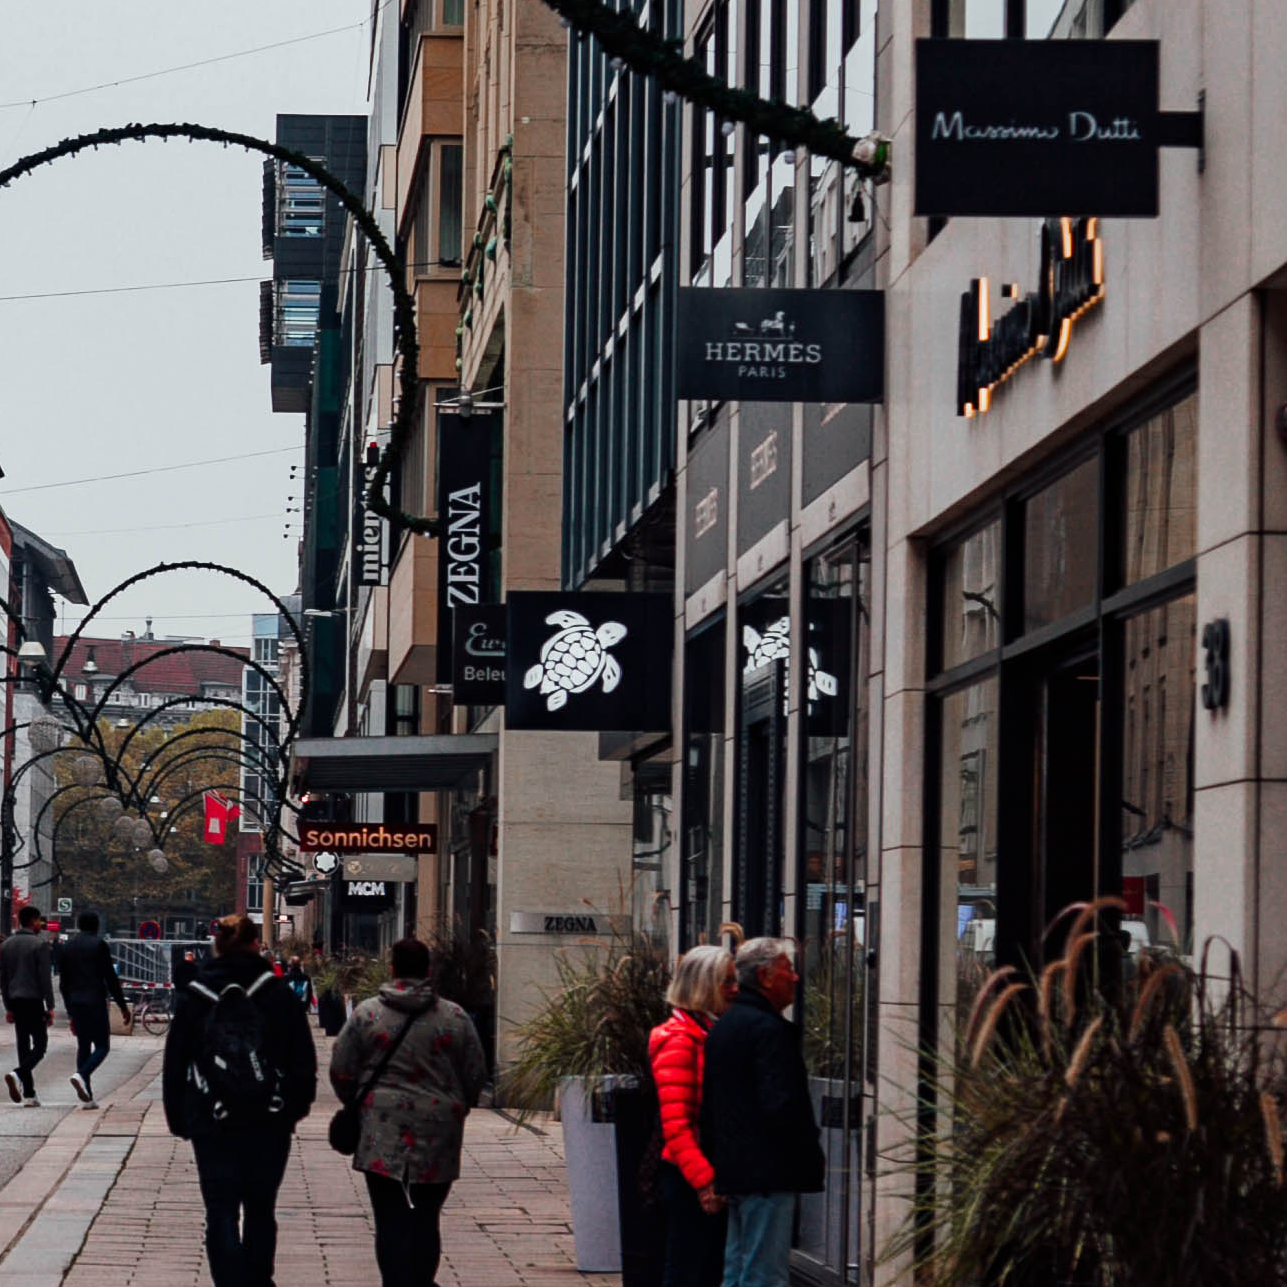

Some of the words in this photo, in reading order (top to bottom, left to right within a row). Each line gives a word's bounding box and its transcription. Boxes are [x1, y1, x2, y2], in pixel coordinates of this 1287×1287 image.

[931, 111, 1060, 141] Massimo
[1069, 111, 1142, 142] Dutti
[738, 365, 786, 378] PARIS
[447, 481, 481, 608] ZEGNA
[347, 881, 386, 896] MCM
[544, 916, 598, 932] ZEGNA
